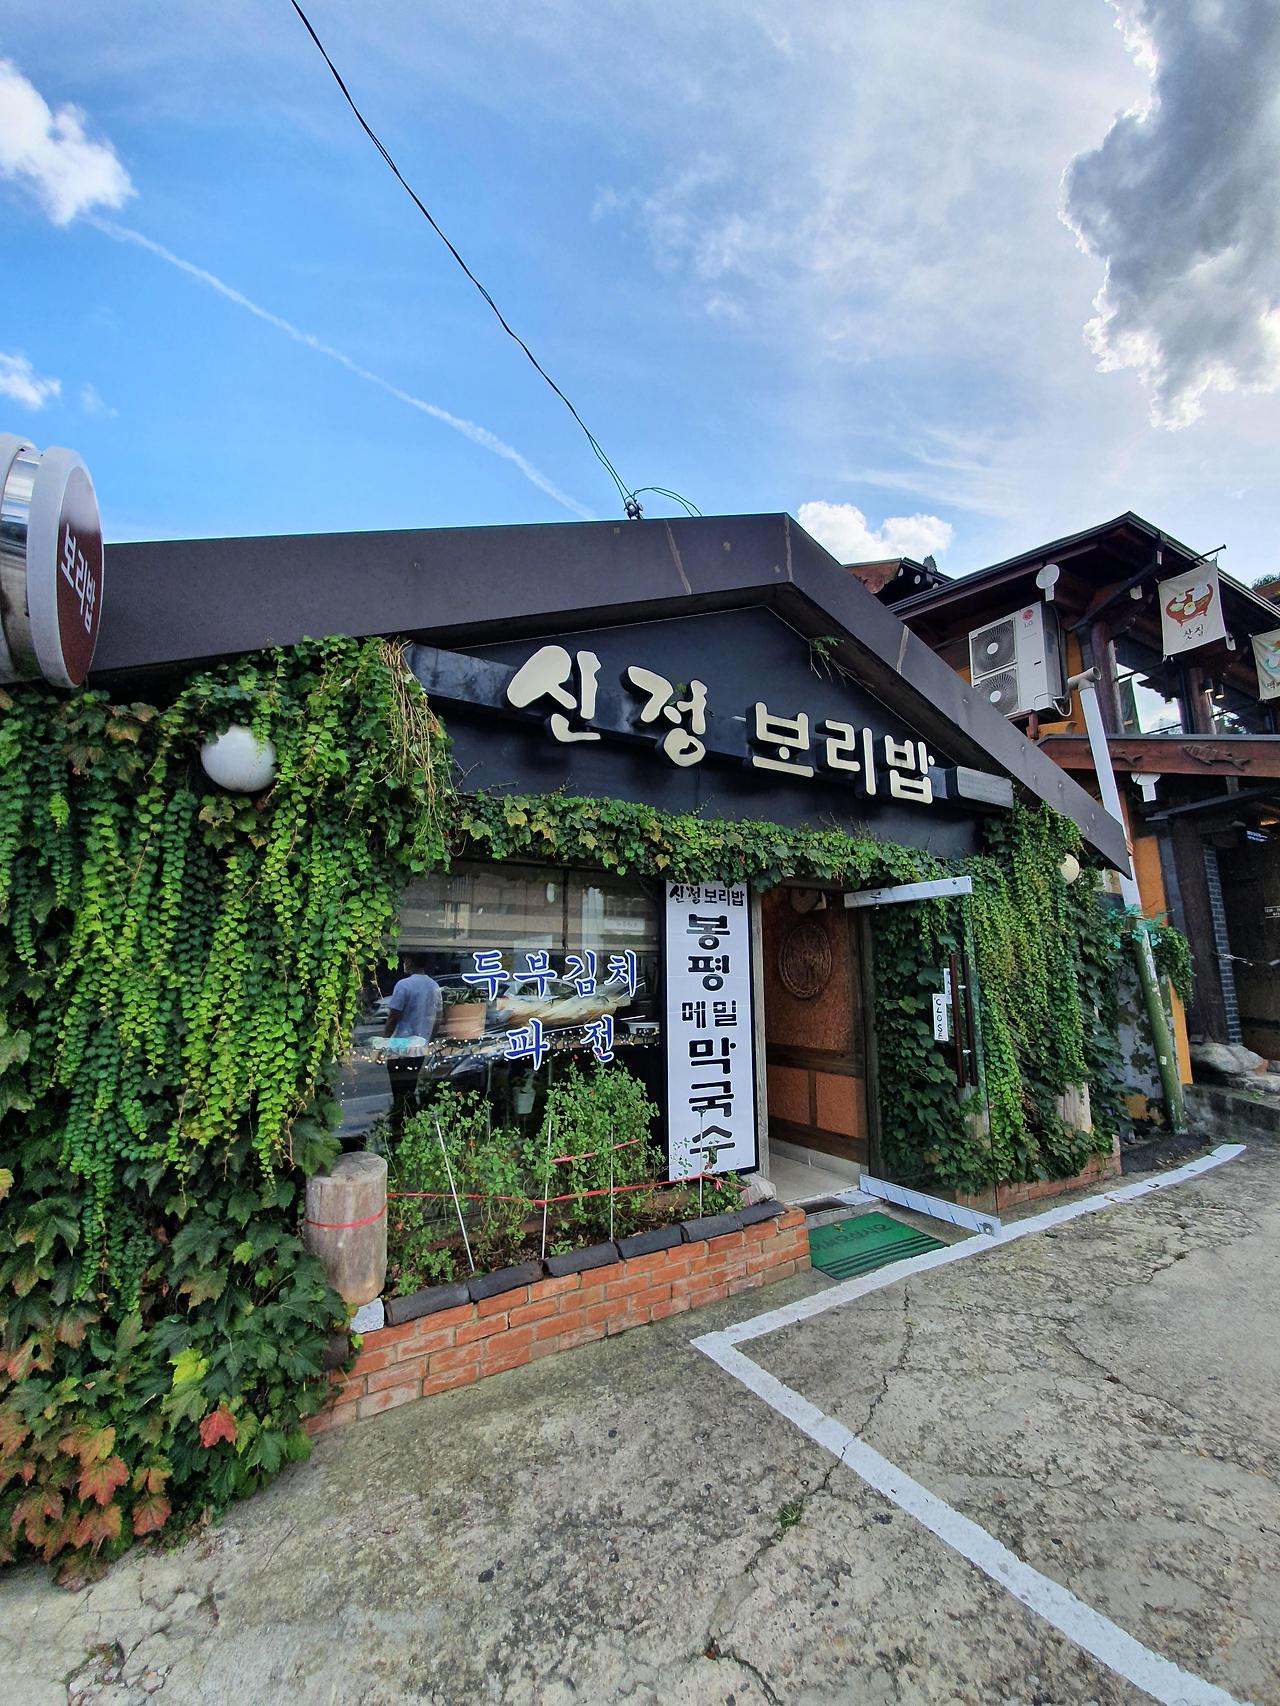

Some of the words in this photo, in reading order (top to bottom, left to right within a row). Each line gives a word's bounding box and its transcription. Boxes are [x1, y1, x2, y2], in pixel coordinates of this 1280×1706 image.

[61, 522, 96, 634] 보리밥
[506, 645, 706, 768] 신정
[752, 702, 935, 804] 보리밥
[704, 888, 745, 906] 보리밥
[461, 950, 637, 1001] 두부김치
[686, 913, 731, 992] 봉평
[682, 1000, 738, 1028] 메밀
[688, 1036, 737, 1165] 막국수
